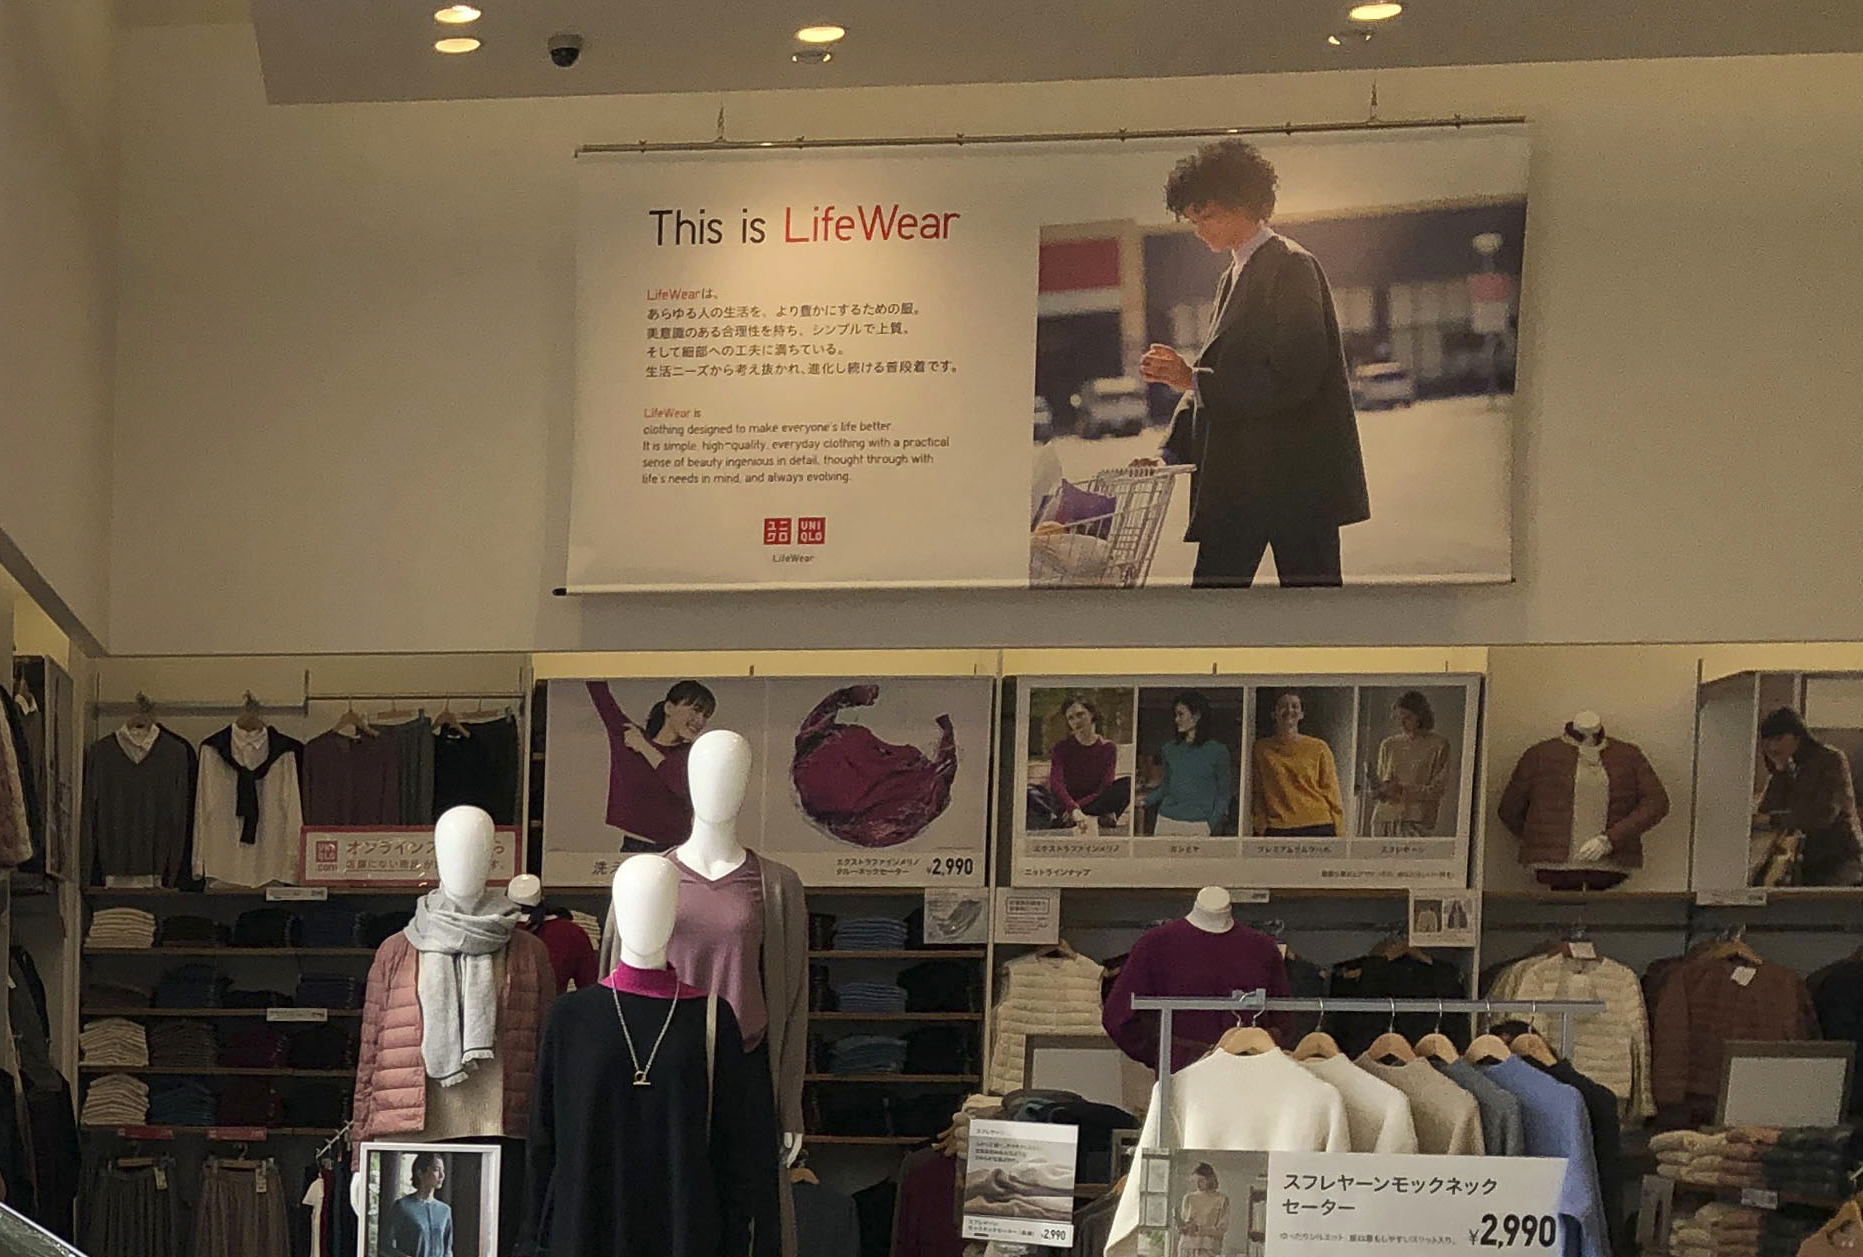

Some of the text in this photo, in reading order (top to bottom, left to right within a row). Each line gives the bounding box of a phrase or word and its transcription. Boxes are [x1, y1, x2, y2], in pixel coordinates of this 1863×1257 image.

[649, 204, 961, 246] This is LifeWear
[644, 408, 701, 418] LifeWear is
[643, 424, 684, 436] clothing
[687, 424, 733, 436] designed
[735, 424, 746, 434] to
[748, 422, 778, 433] make
[841, 421, 856, 432] life
[643, 441, 650, 451] It
[652, 441, 660, 451] is
[772, 439, 820, 452] everyday
[823, 438, 866, 450] clothing
[868, 437, 890, 448] with
[893, 439, 900, 447] a
[902, 436, 950, 449] practical
[642, 458, 671, 467] sense
[674, 457, 684, 467] of
[725, 456, 774, 469] ingenious
[777, 456, 786, 466] in
[823, 454, 863, 467] thought
[866, 453, 909, 466] through
[911, 453, 934, 464] with
[668, 473, 699, 483] needs
[701, 473, 711, 483] in
[745, 472, 765, 483] and
[767, 472, 804, 484] always
[801, 520, 822, 531] UNI
[800, 532, 823, 542] QLO
[772, 553, 815, 563] LifeWear
[1283, 1173, 1498, 1196] スフレヤーンモックネック
[1282, 1198, 1356, 1216] セーター
[1469, 1213, 1557, 1250] ¥2,990
